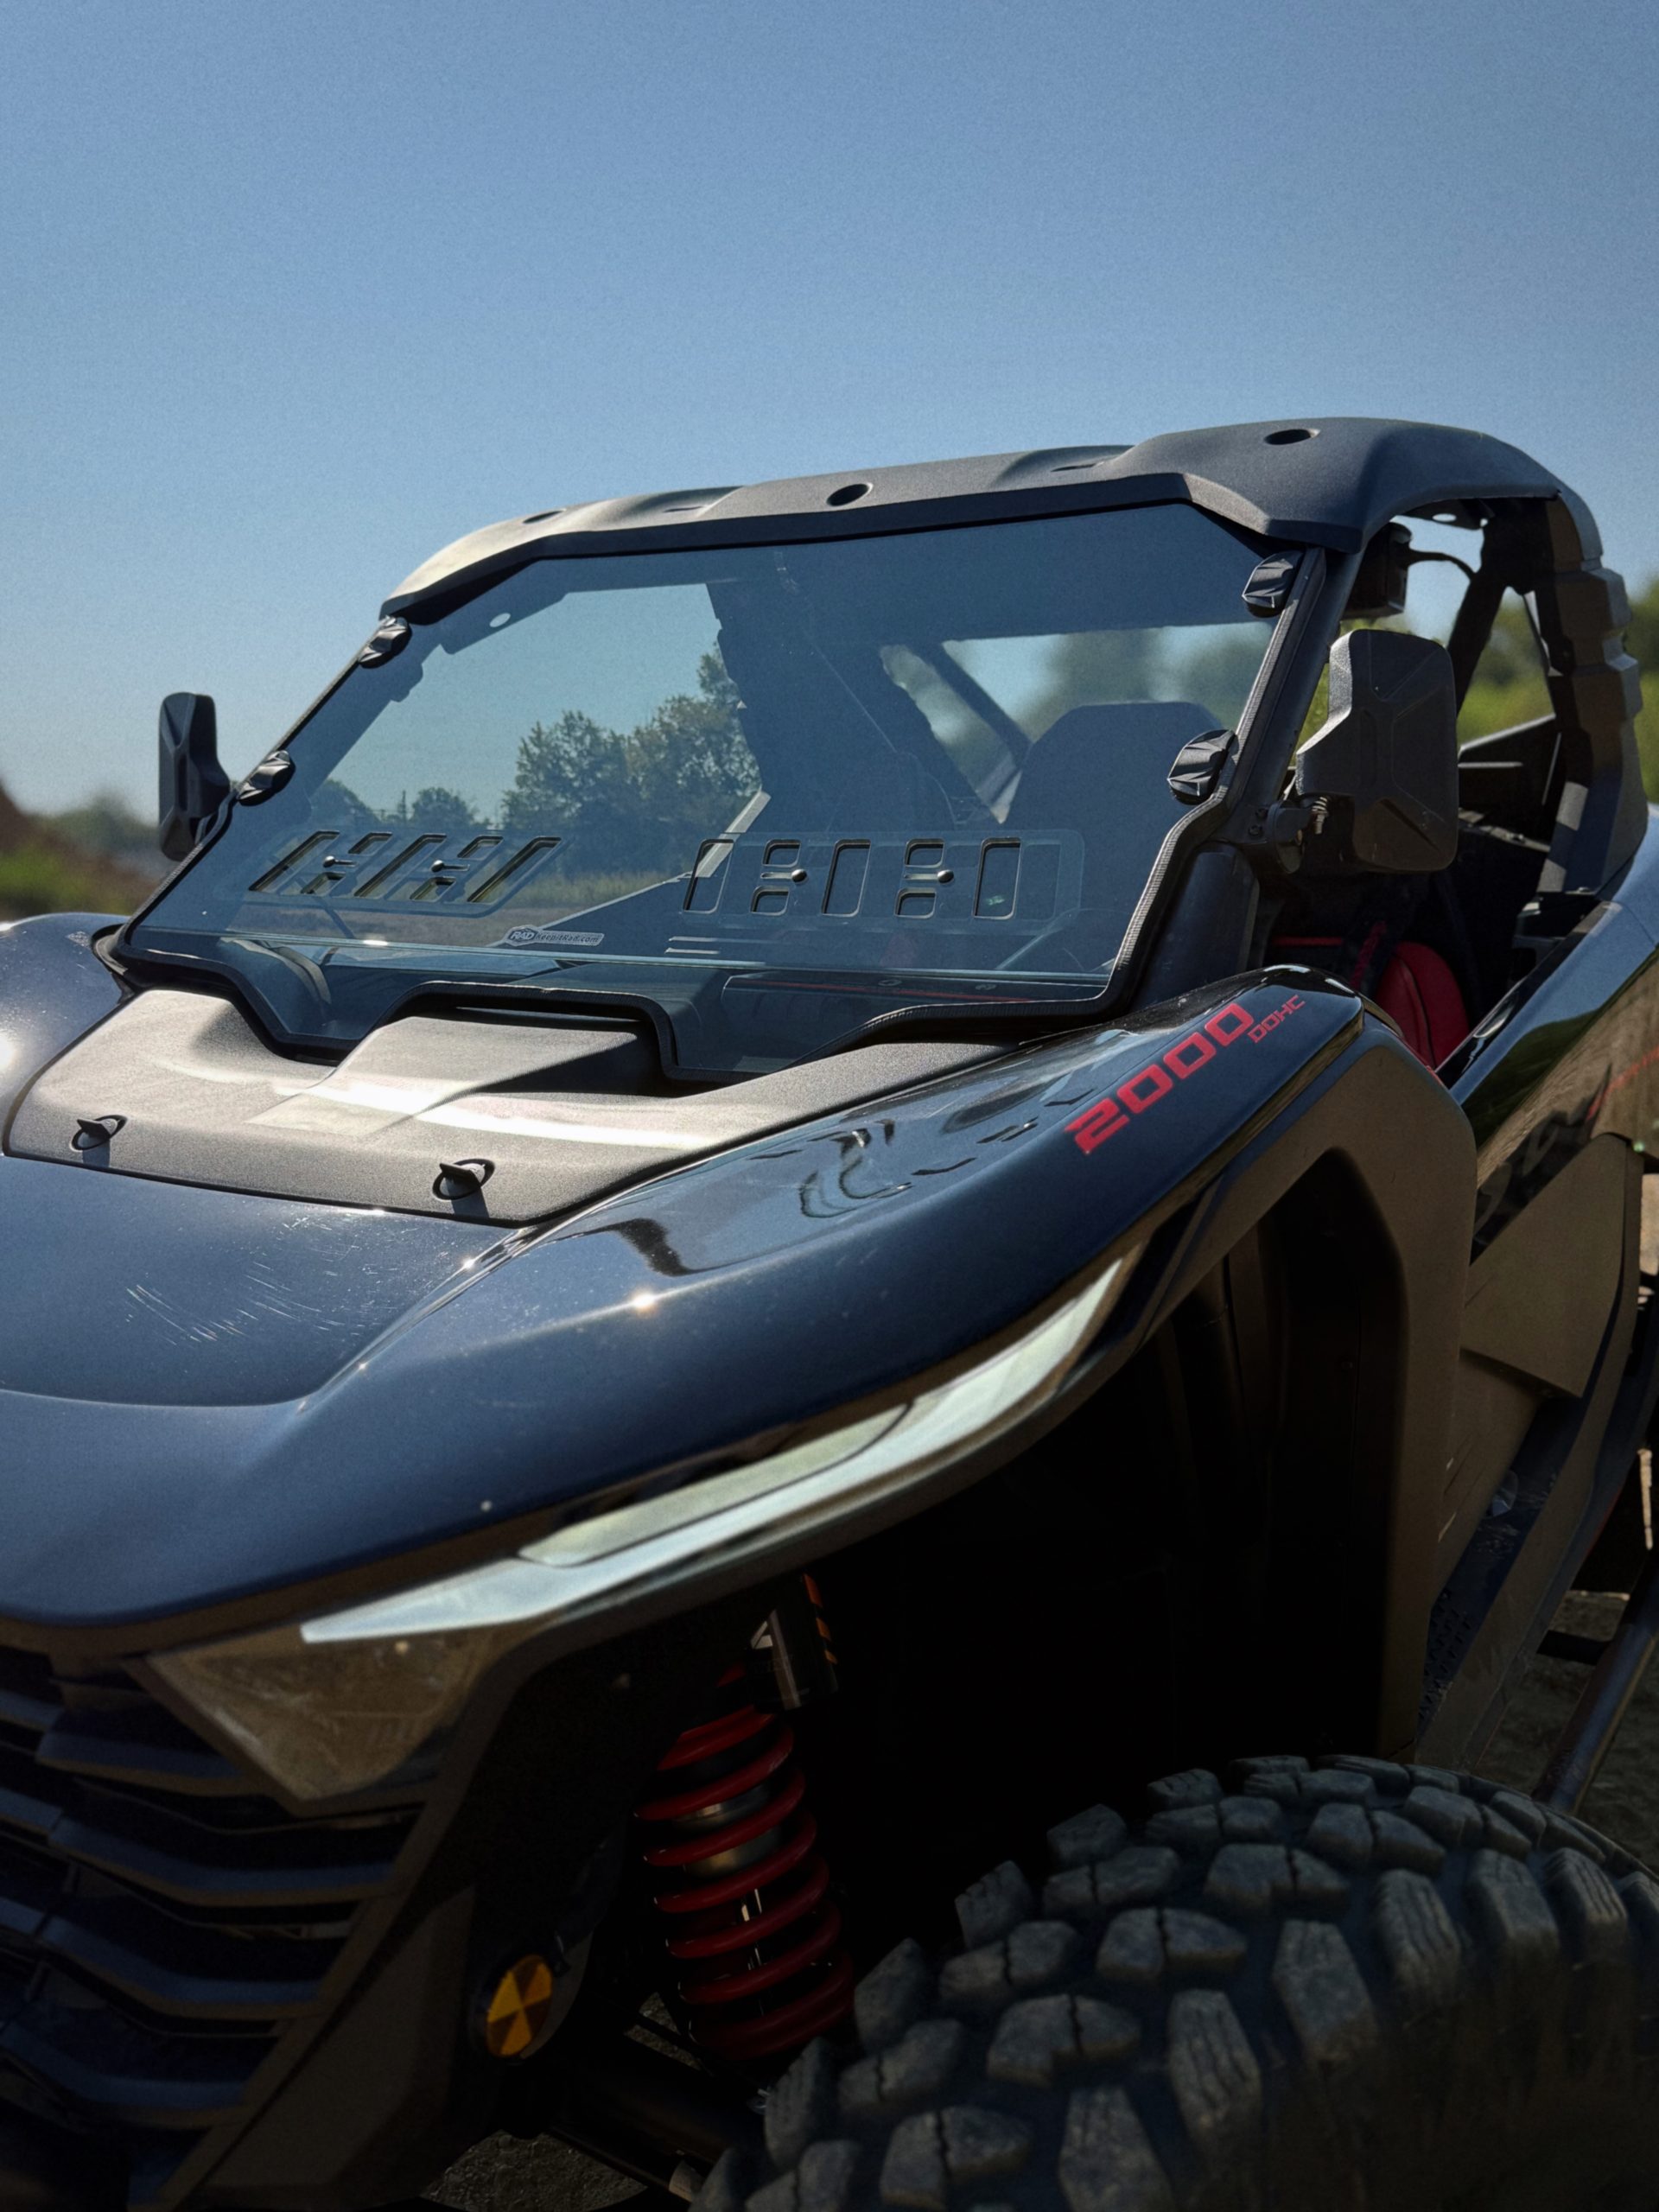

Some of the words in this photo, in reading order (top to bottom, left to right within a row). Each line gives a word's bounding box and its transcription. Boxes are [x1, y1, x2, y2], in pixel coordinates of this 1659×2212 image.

[510, 931, 536, 941] RAD
[1247, 995, 1306, 1043] DOHC
[1064, 1003, 1254, 1154] 2000
